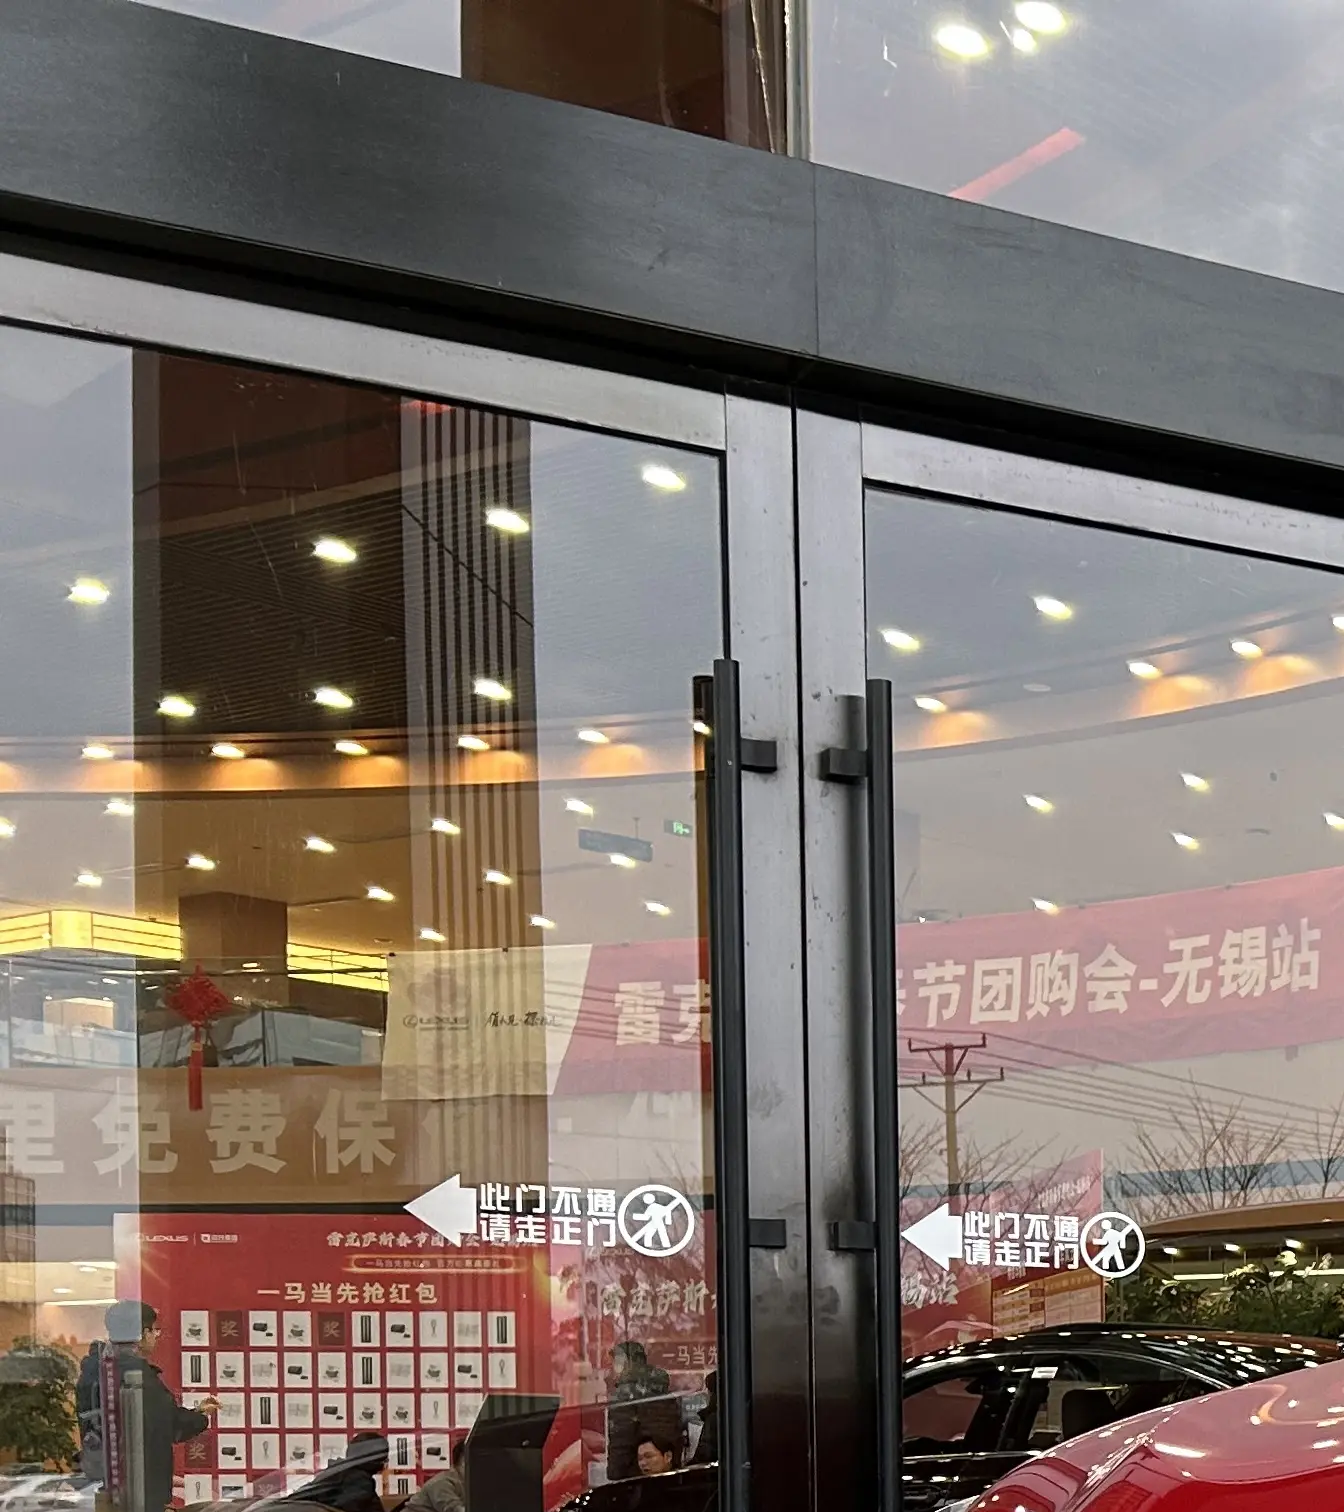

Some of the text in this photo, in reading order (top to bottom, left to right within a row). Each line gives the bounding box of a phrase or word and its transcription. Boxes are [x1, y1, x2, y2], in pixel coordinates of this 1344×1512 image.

[479, 1182, 617, 1217] 此门不通
[479, 1212, 617, 1248] 请走正门
[964, 1210, 1080, 1243] 此门不通
[964, 1238, 1080, 1271] 请走正门
[257, 1281, 439, 1305] 一马当先抢红包
